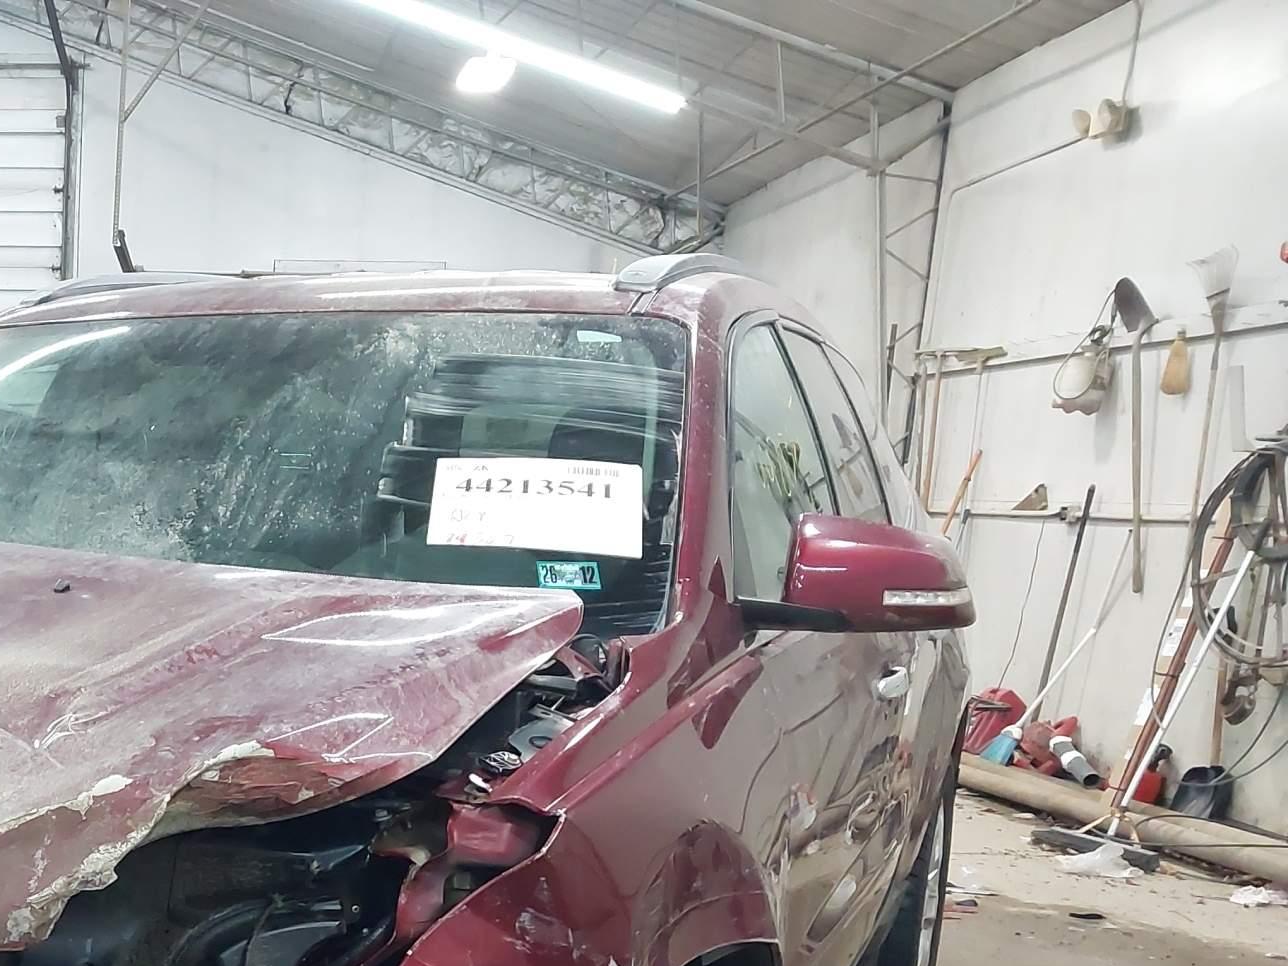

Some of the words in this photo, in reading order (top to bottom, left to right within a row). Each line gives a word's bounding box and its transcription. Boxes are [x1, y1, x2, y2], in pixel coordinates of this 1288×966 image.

[455, 478, 612, 499] 44213541
[541, 565, 558, 584] 26
[579, 565, 597, 584] 12
